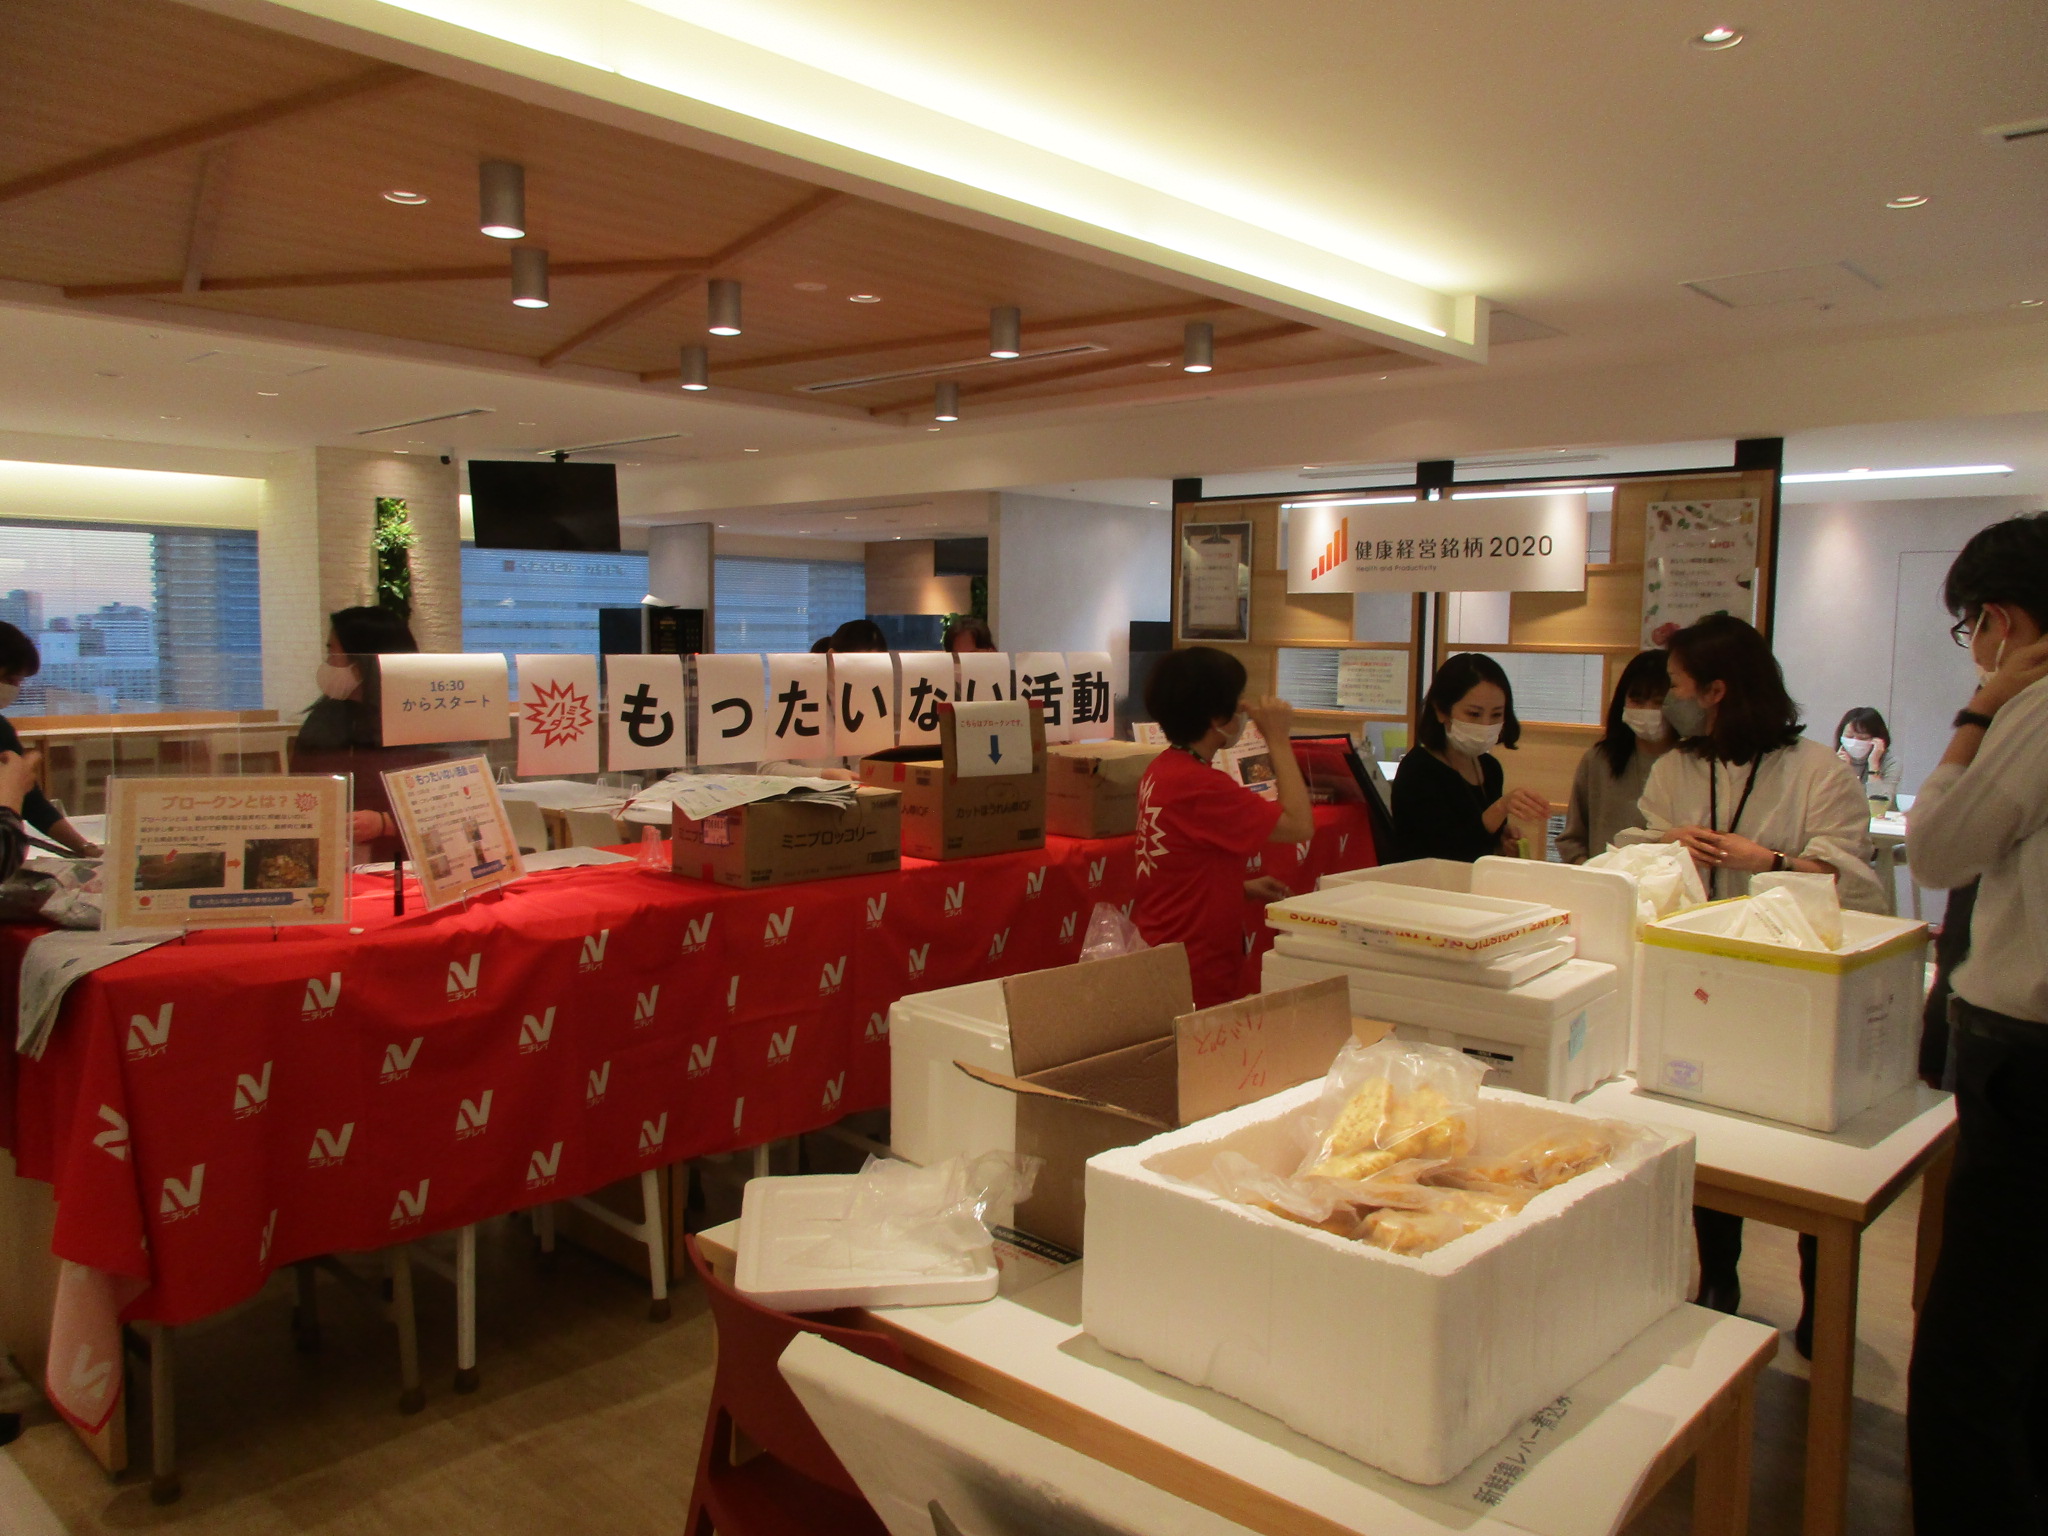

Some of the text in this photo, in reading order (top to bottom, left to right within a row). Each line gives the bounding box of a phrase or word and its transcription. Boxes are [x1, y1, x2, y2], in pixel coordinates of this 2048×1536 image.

[1356, 564, 1437, 573] Health and Productivity
[430, 680, 465, 692] 16:30
[402, 694, 490, 712] からスタート
[960, 719, 1024, 728] こちらはブロークンです。
[781, 826, 878, 850] ミニブロッコリー
[301, 1008, 335, 1022] ニチレイ
[127, 1044, 168, 1062] ニチレイ
